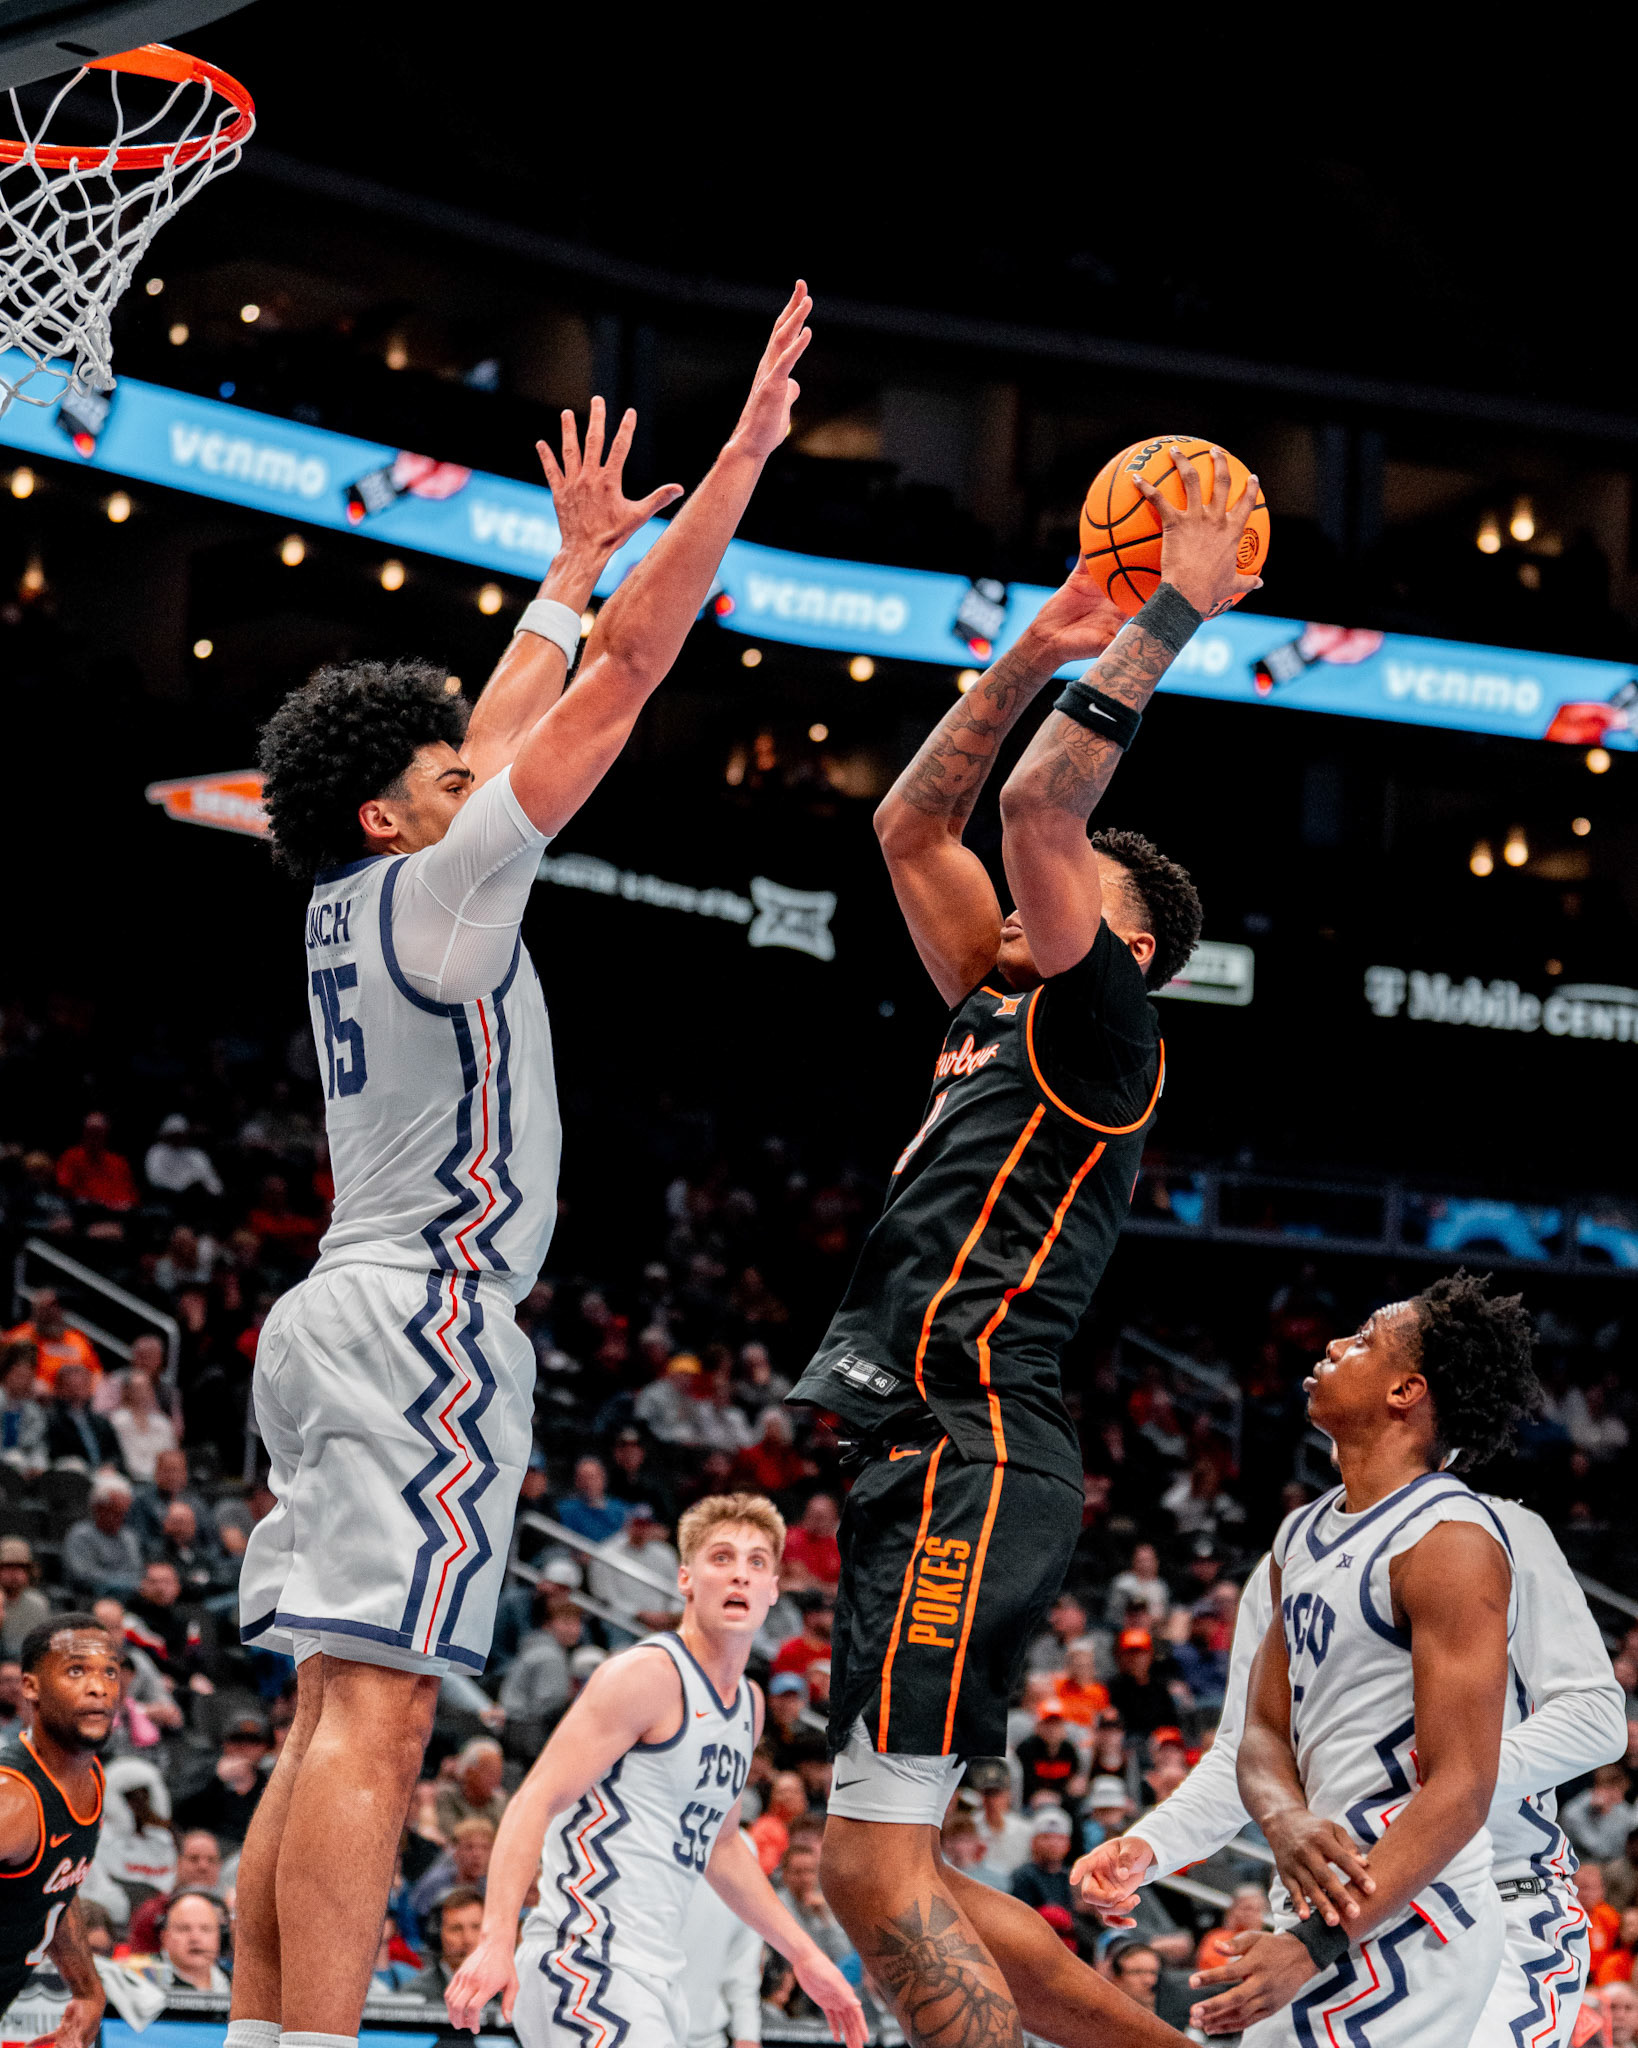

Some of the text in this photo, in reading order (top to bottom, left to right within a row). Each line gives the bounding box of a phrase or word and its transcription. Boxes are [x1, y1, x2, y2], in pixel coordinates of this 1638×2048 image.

[169, 422, 328, 498] venmo
[745, 573, 909, 634] venmo
[1381, 658, 1544, 716] venmo
[306, 899, 351, 949] UNCH
[311, 962, 368, 1100] 15
[1543, 1000, 1638, 1043] CENT
[874, 1376, 888, 1389] 46
[907, 1536, 971, 1649] POKES
[694, 1743, 747, 1800] TCU
[672, 1800, 724, 1873] 55
[1520, 1881, 1533, 1890] 48
[25, 1901, 66, 1966] 1
